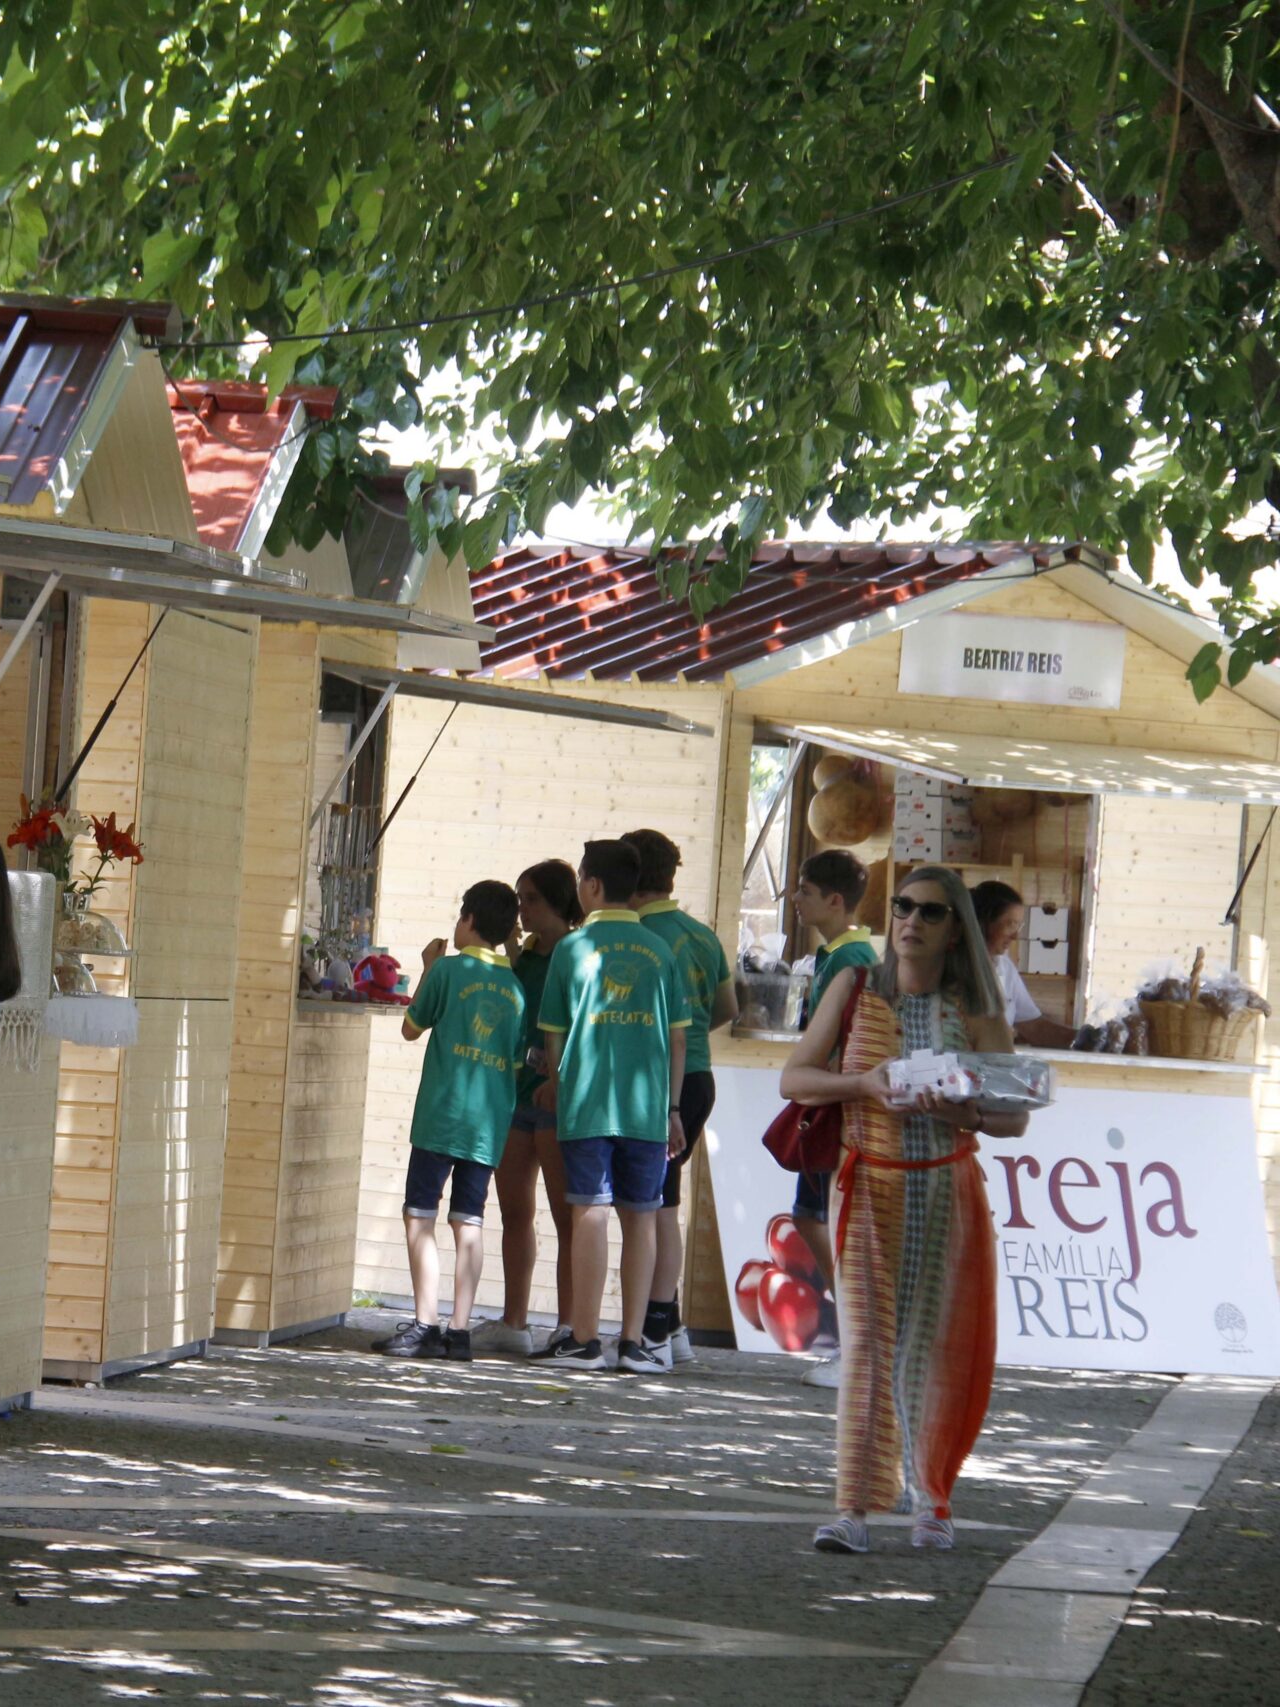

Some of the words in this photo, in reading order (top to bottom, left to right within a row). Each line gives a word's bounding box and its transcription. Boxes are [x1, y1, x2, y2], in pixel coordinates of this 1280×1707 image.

[963, 647, 1024, 672] BEATRIZ
[1027, 651, 1063, 675] REIS
[983, 1127, 1198, 1282] reja
[1003, 1235, 1127, 1278] FAMÍLIA
[1006, 1274, 1149, 1342] REIS
